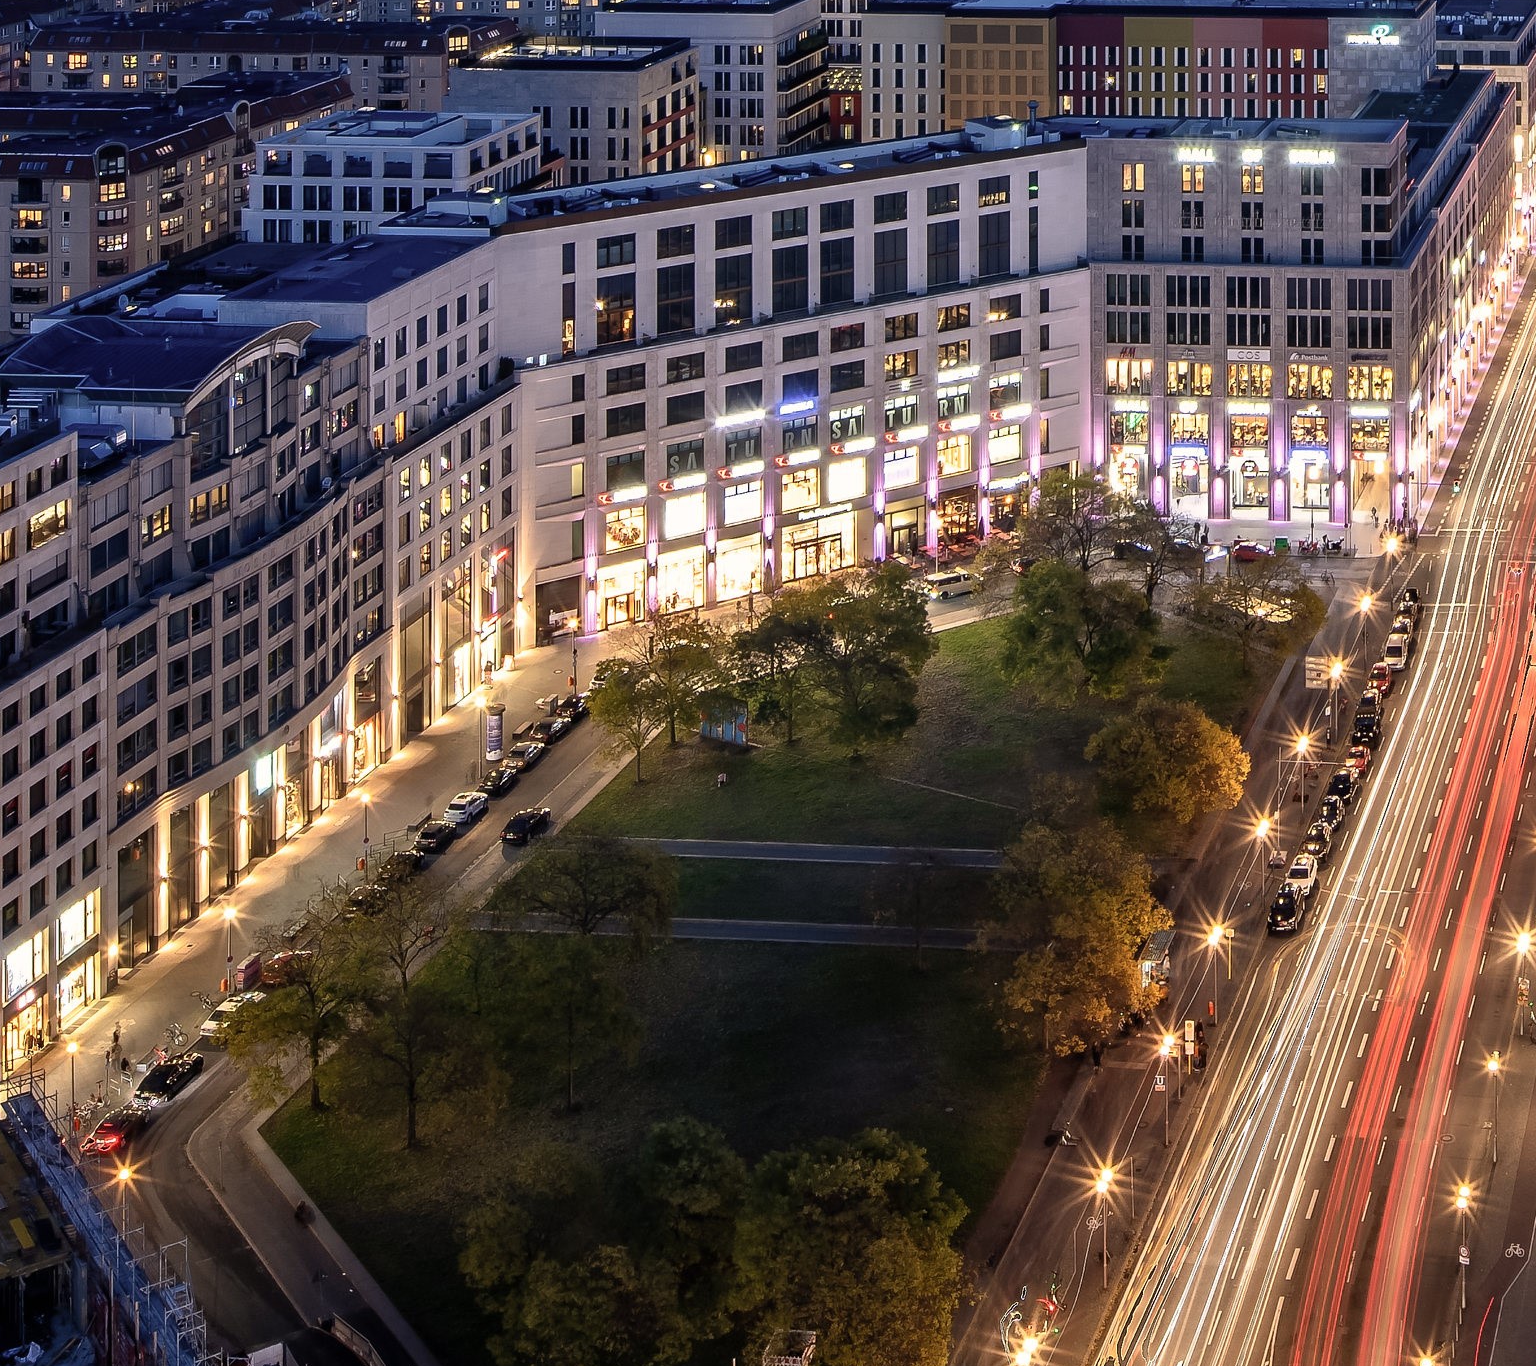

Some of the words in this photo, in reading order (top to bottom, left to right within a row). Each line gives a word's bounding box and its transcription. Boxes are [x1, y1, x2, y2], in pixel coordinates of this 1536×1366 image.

[1237, 351, 1260, 360] COS
[1301, 353, 1329, 361] Postbank
[832, 396, 965, 439] SATURN
[669, 428, 813, 473] SATURN
